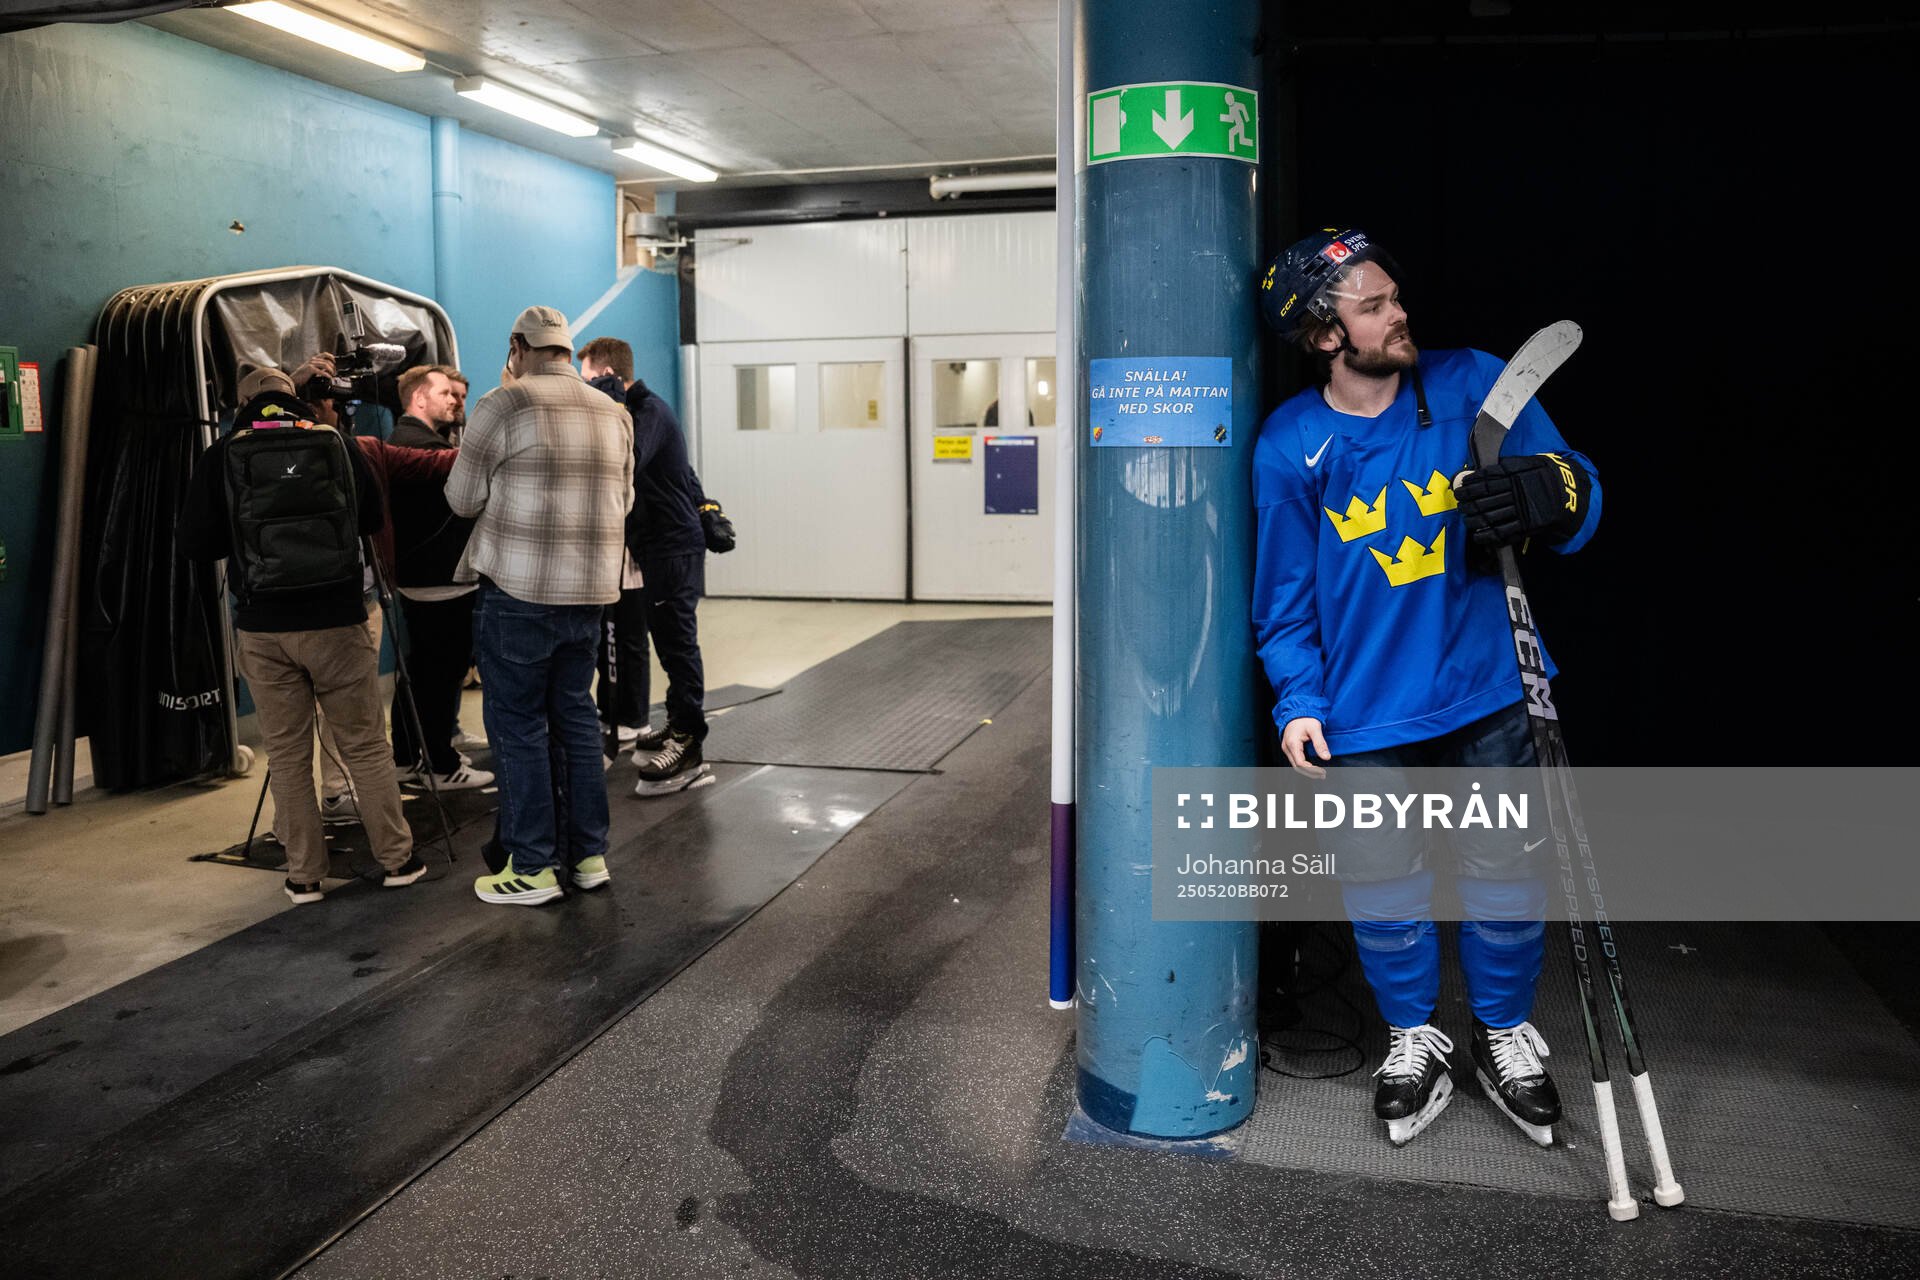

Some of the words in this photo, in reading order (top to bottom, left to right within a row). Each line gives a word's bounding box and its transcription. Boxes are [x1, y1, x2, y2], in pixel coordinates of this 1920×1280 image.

[1351, 240, 1369, 253] SPEL
[1280, 293, 1298, 317] CCM
[1124, 367, 1188, 382] SNÄLLA!
[1091, 384, 1106, 399] GÅ
[1108, 387, 1141, 399] INTE
[1144, 384, 1164, 398] PÅ
[1169, 387, 1229, 399] MATTAN
[1118, 403, 1149, 415] MED
[1152, 402, 1194, 414] SKOR
[607, 620, 617, 684] CCM
[1505, 585, 1545, 718] CCM
[1554, 828, 1590, 963] JETSPEED
[1574, 827, 1617, 959] JETSPEED
